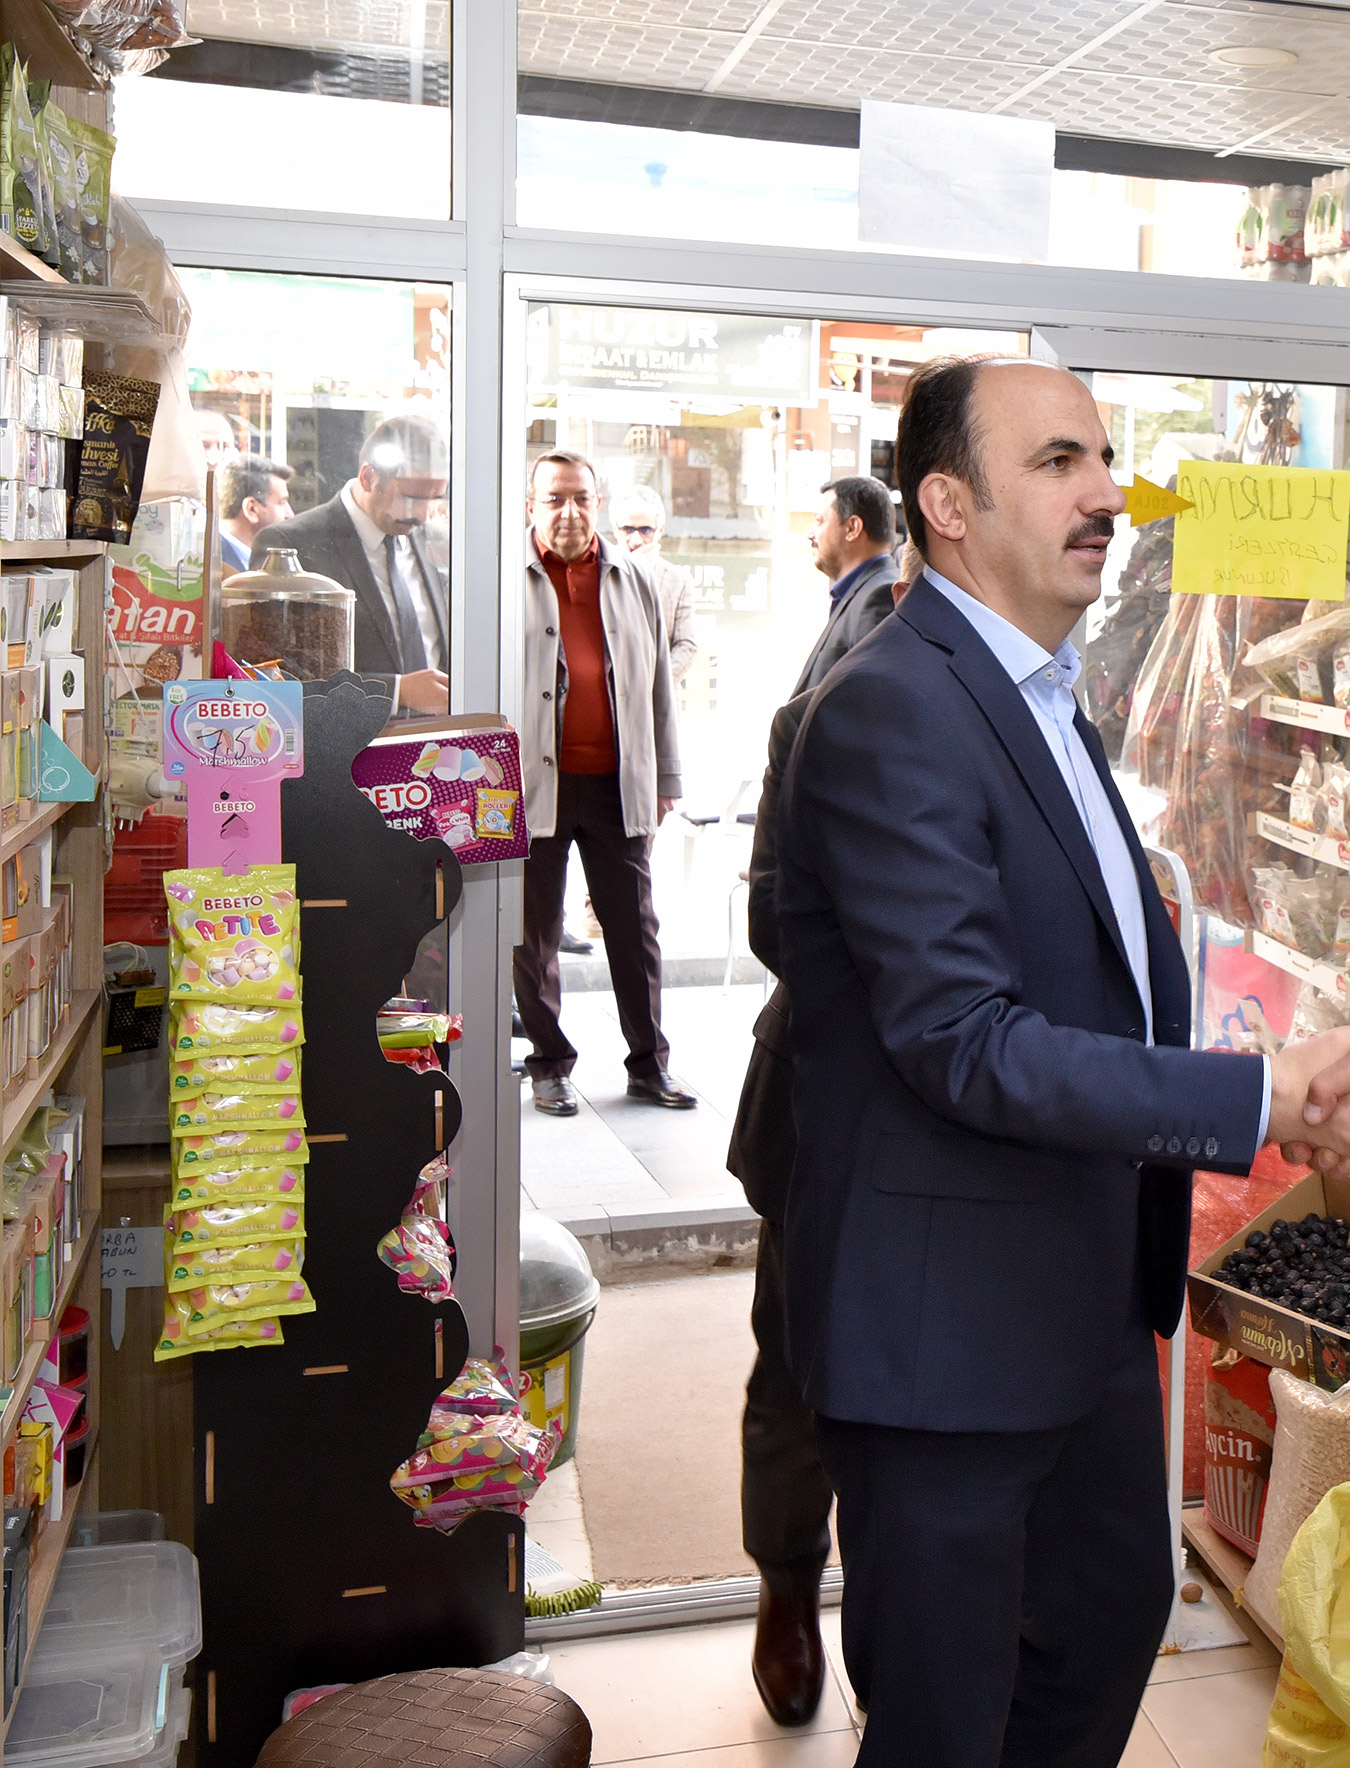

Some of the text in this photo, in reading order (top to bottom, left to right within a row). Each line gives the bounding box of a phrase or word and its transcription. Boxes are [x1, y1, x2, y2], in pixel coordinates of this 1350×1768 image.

[558, 308, 719, 350] HUZUR
[197, 702, 268, 718] BEBETO
[199, 756, 269, 768] Marshmallow
[213, 801, 256, 813] BEBETO
[203, 895, 264, 911] BEBETO
[195, 910, 281, 942] PETITE
